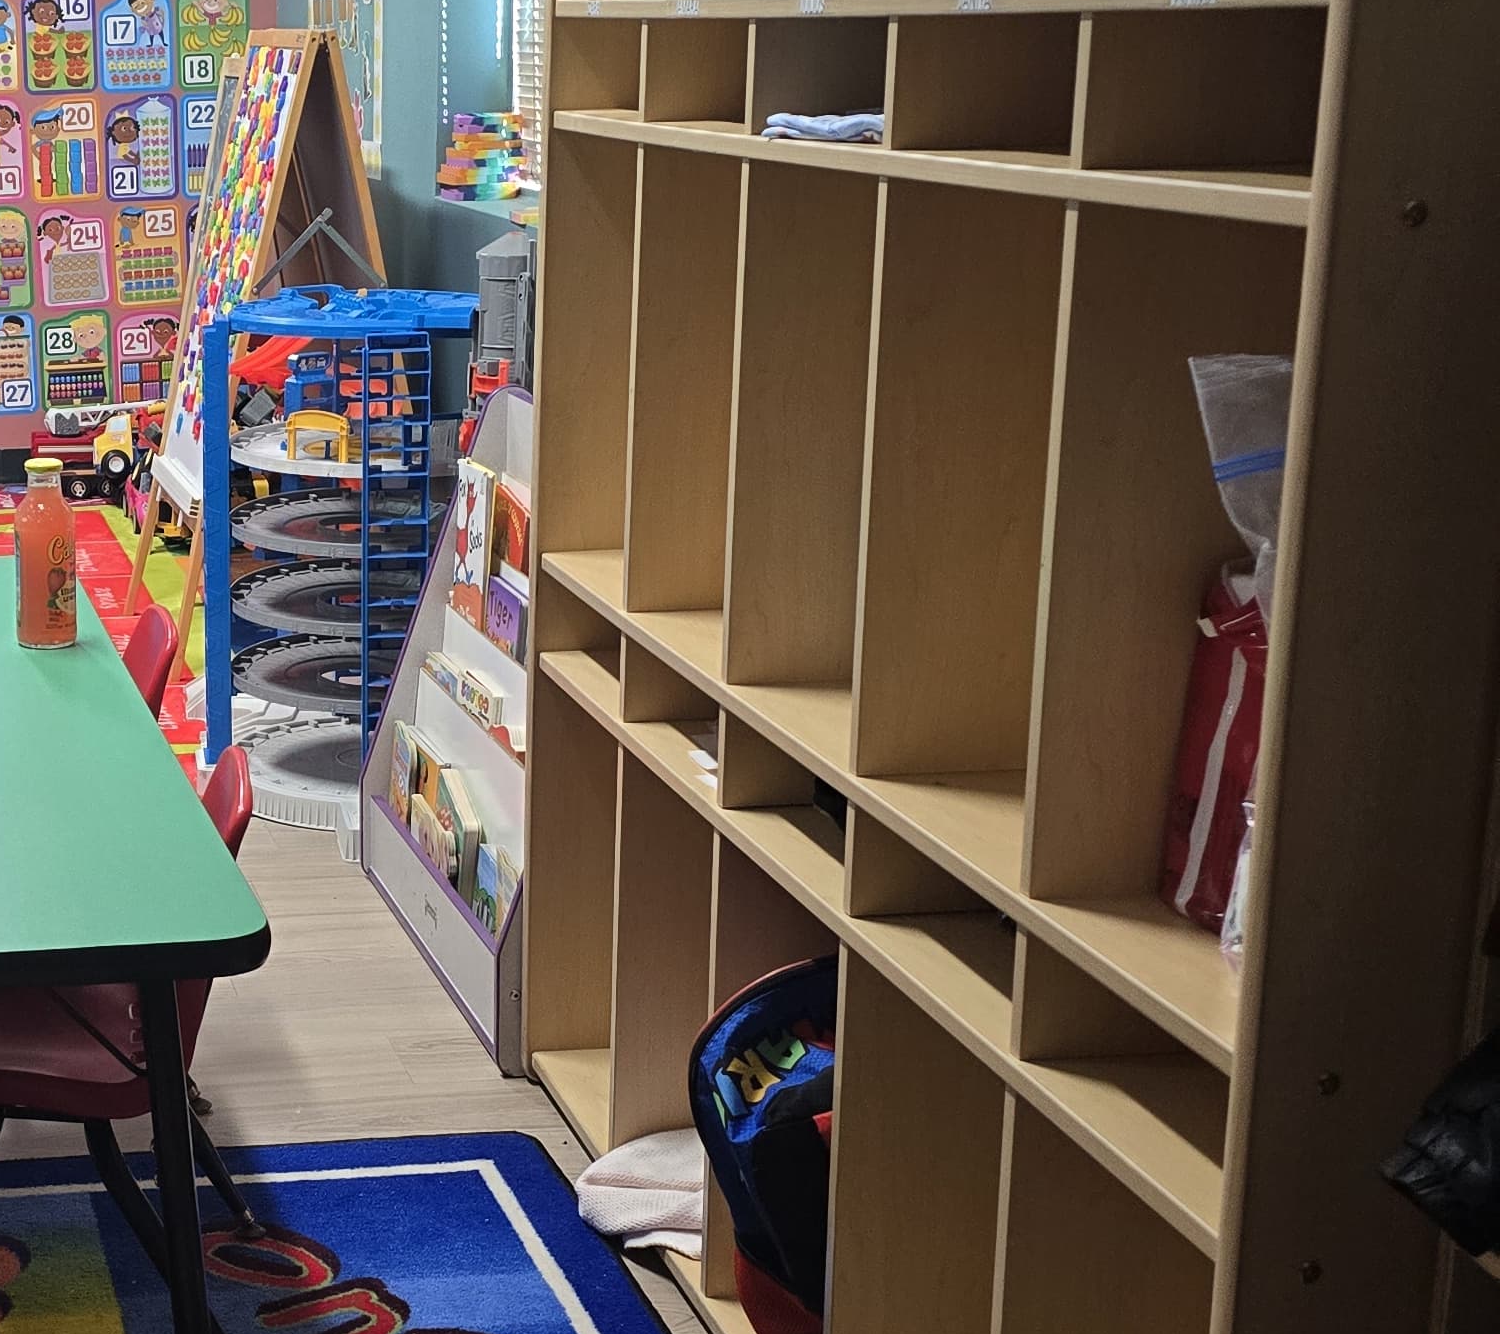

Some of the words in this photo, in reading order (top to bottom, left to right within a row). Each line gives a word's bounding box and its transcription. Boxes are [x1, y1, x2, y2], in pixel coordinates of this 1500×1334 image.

[113, 21, 131, 39] 17
[189, 59, 208, 77] 18
[65, 106, 90, 125] 20
[192, 105, 214, 123] 22
[115, 171, 135, 189] 21
[147, 215, 172, 232] 25
[73, 227, 98, 245] 24
[49, 333, 72, 350] 28
[124, 334, 147, 350] 29
[6, 385, 29, 403] 27
[490, 590, 513, 629] Tiger
